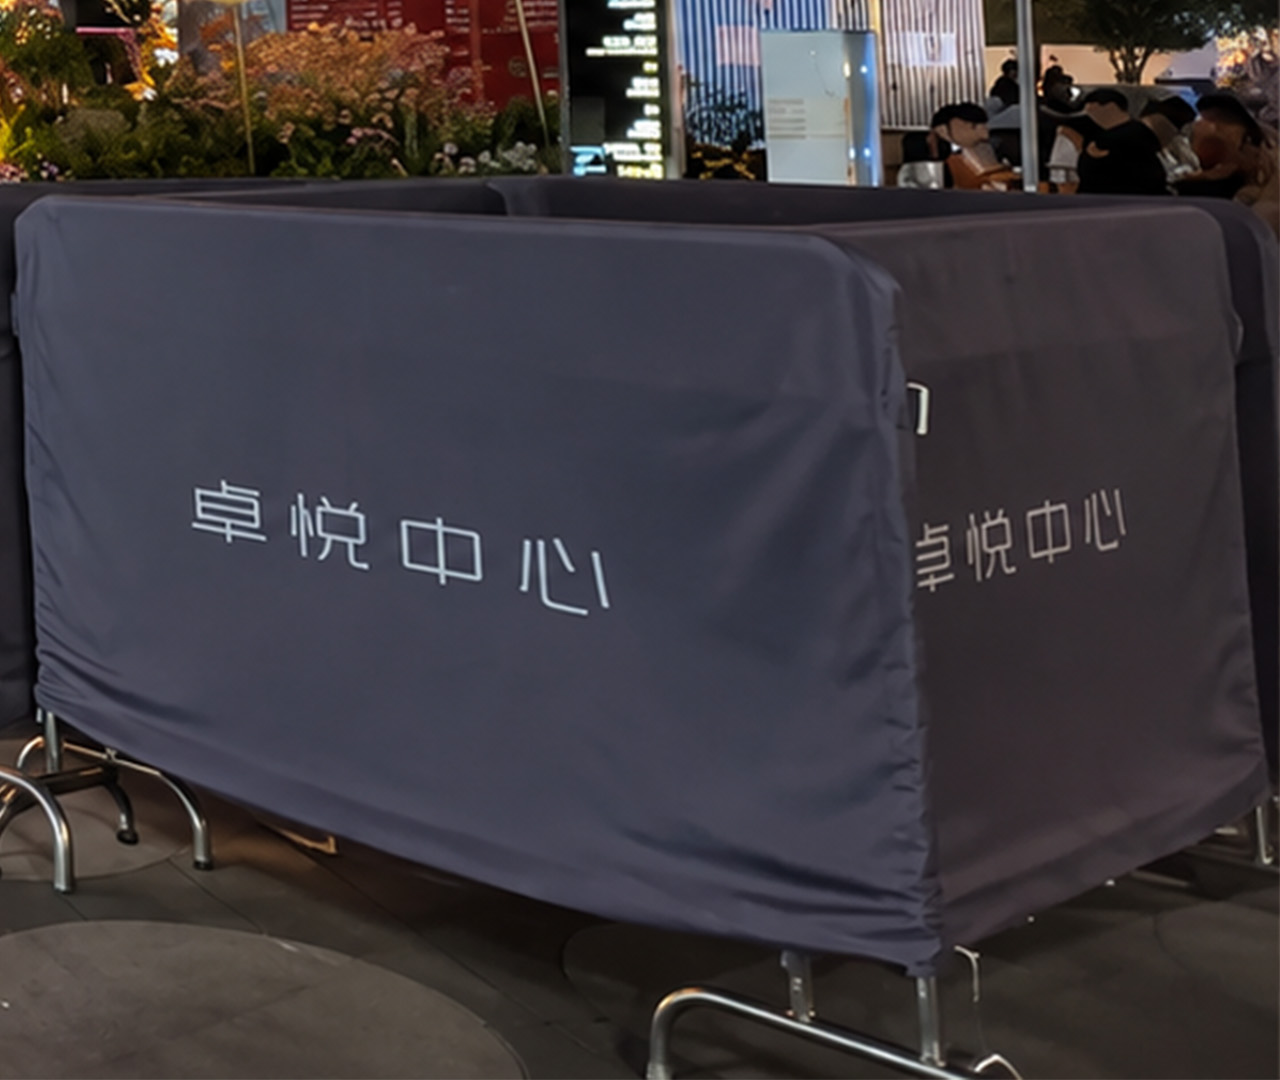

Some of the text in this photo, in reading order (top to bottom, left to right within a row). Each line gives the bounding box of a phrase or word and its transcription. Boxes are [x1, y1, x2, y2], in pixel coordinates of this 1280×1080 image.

[191, 480, 610, 616] 卓悦中心
[915, 488, 1126, 592] 卓悦中心
